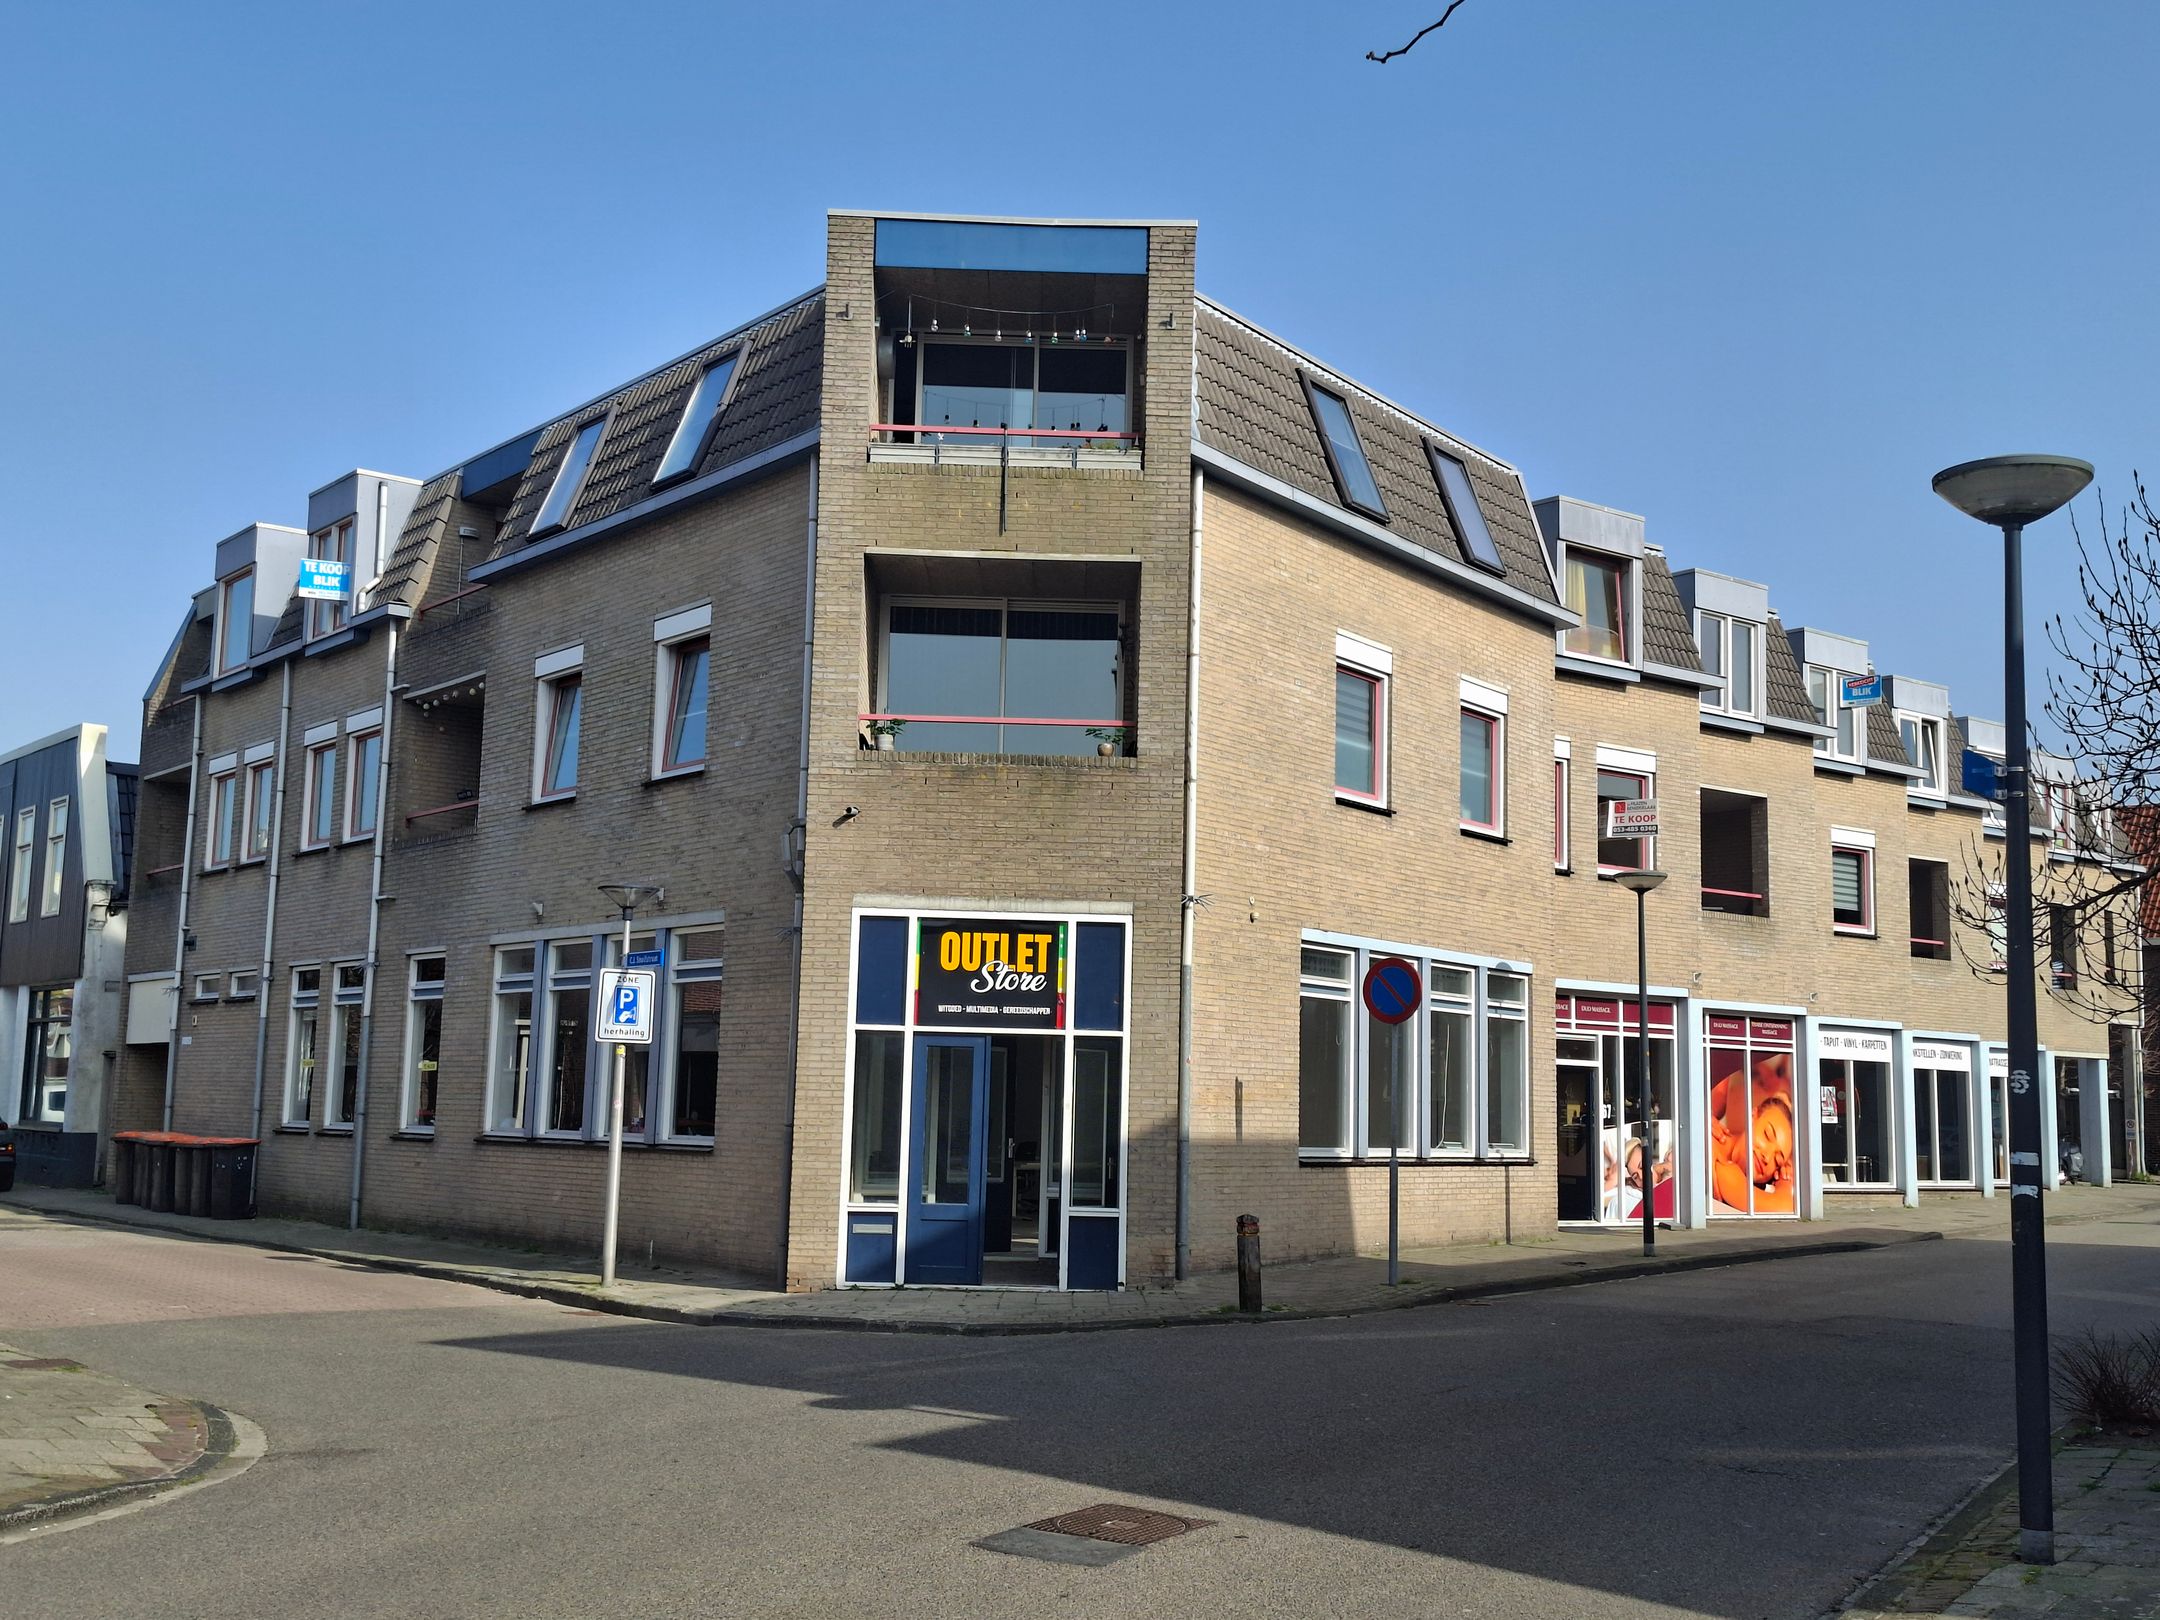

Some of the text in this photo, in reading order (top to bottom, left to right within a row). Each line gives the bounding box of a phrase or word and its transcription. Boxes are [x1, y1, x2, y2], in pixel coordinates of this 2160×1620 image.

[304, 561, 350, 575] TE KOOP
[313, 574, 341, 587] BLIK
[1852, 687, 1872, 696] BLIK
[1614, 815, 1656, 824] TE KOOP
[940, 931, 1052, 973] OUTLET
[616, 975, 640, 984] ZONE
[970, 960, 1047, 993] Store
[620, 989, 634, 1009] P
[966, 1005, 998, 1014] MULTIMEDIA
[604, 1028, 645, 1037] herhaling
[1843, 1038, 1858, 1048] VINYL
[1861, 1039, 1887, 1050] KARPETTEN
